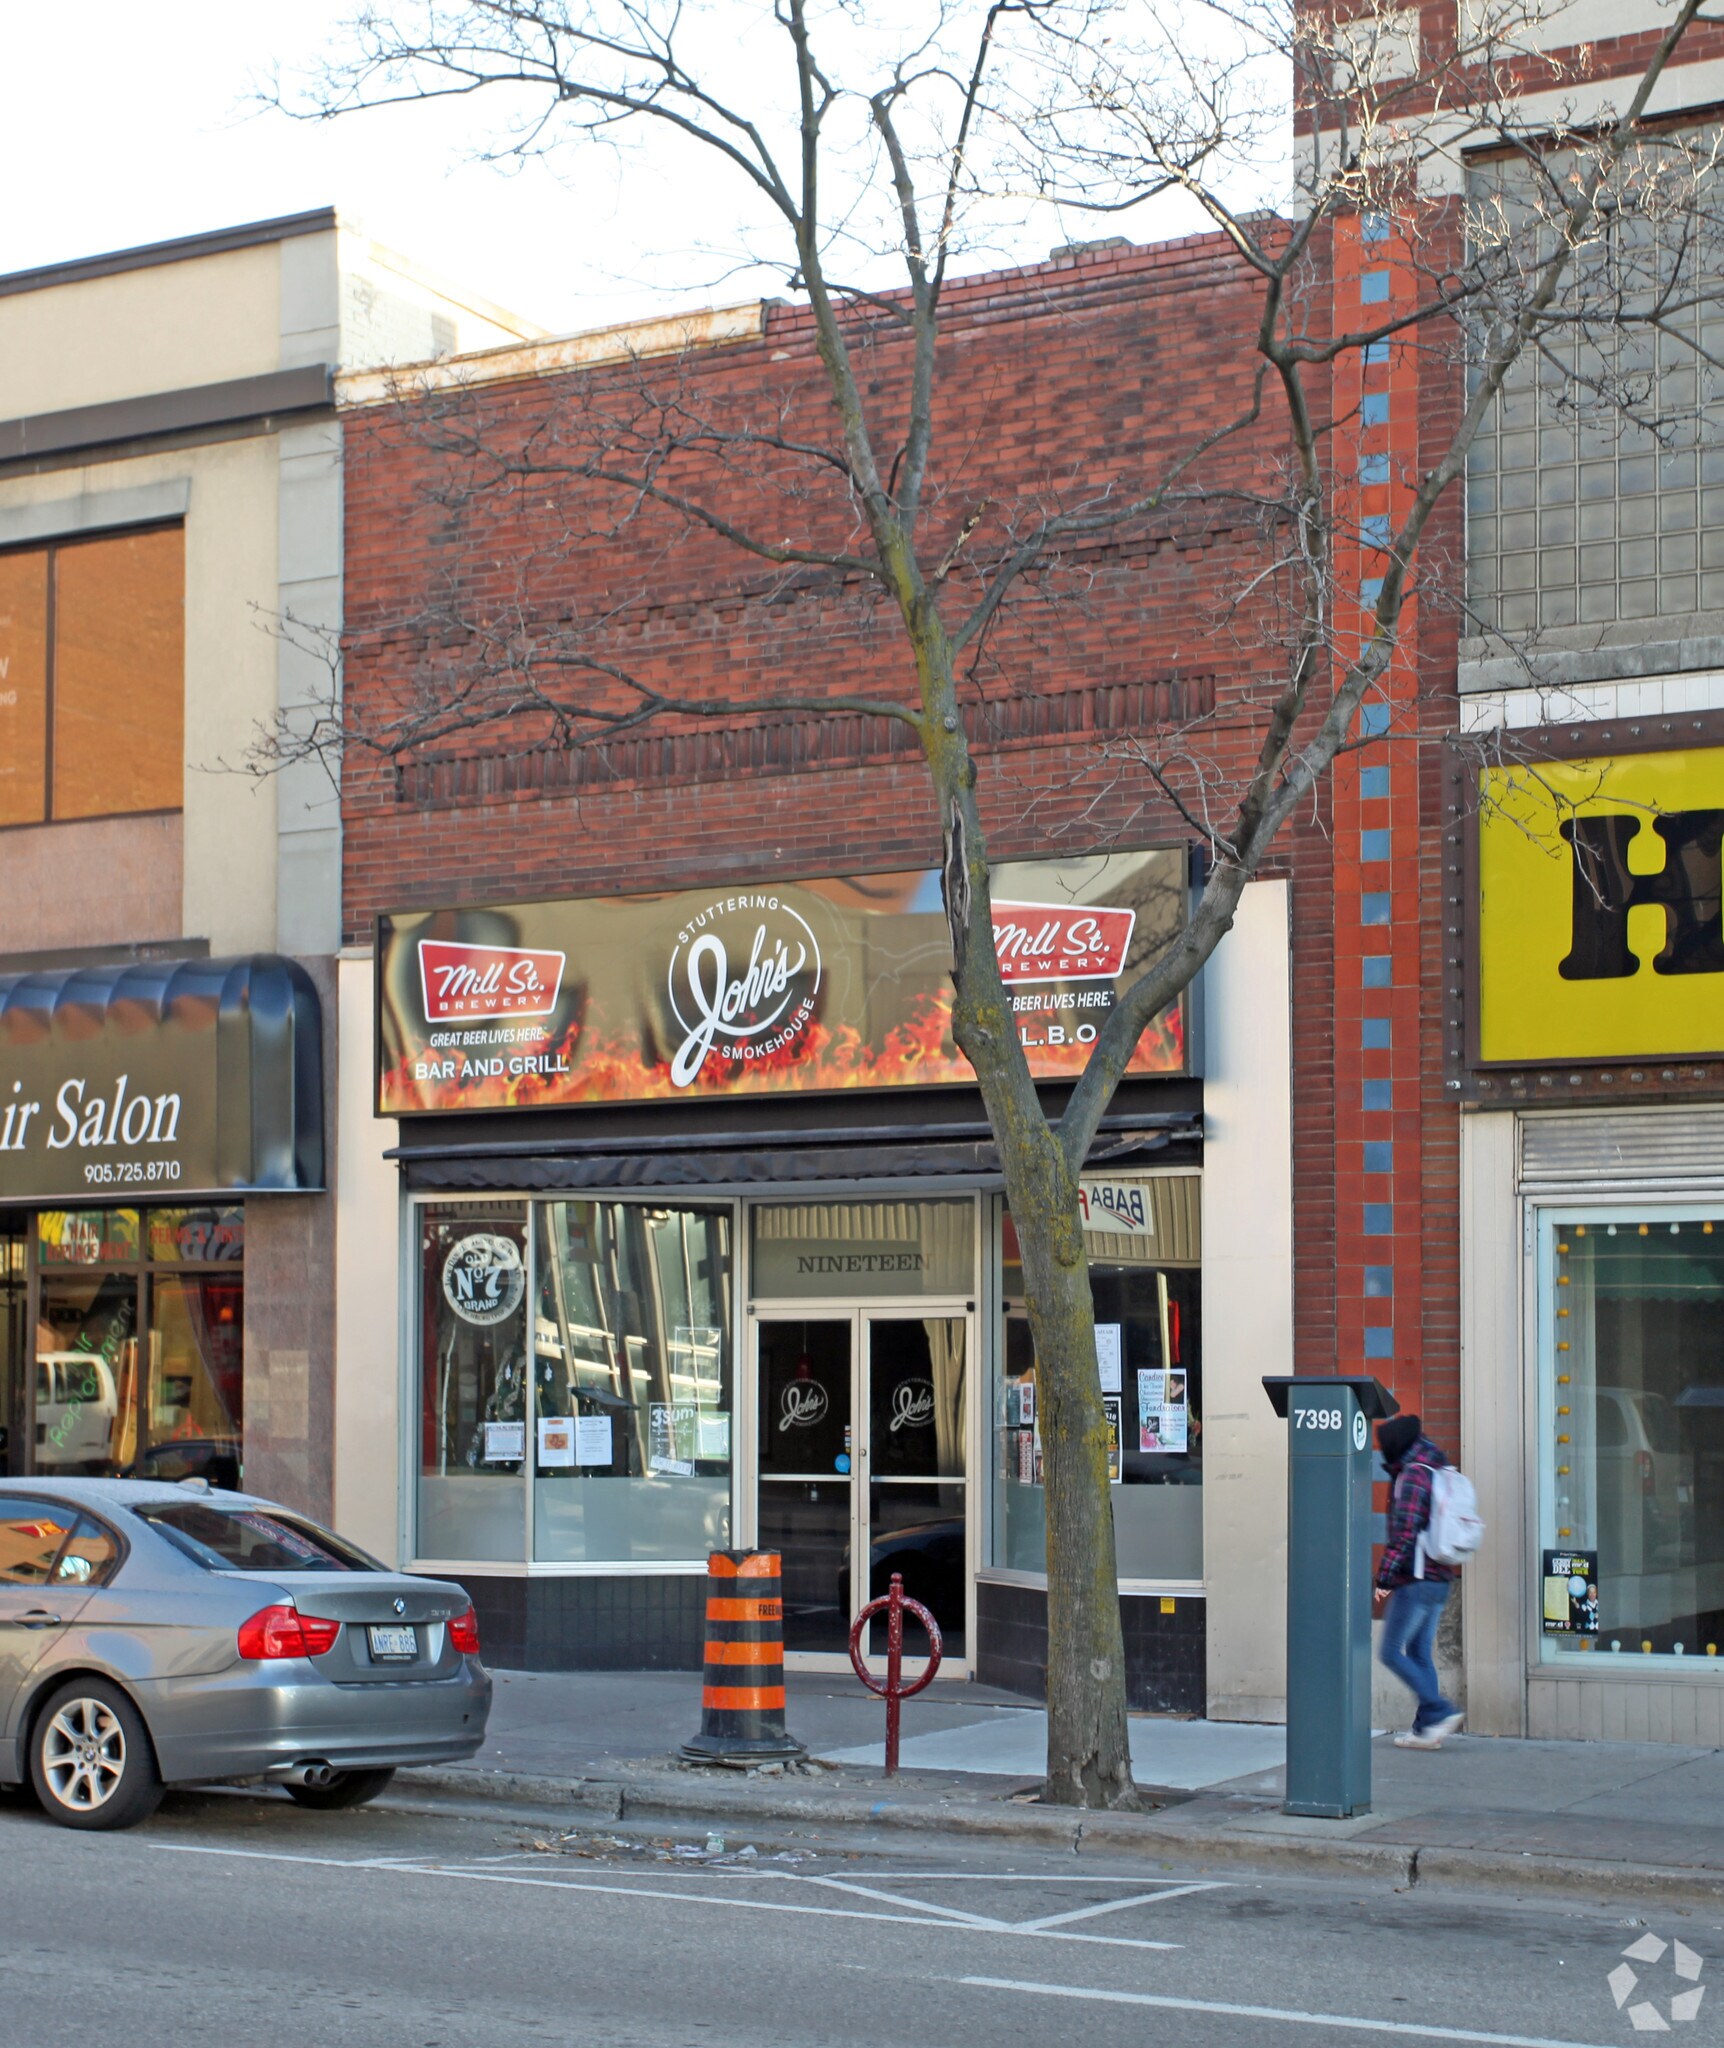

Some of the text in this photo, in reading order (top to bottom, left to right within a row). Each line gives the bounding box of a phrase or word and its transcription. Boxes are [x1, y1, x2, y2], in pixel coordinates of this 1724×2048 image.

[677, 895, 779, 943] STUTTERING
[991, 918, 1111, 958] Mill St.
[1002, 957, 1107, 973] REWERY
[433, 960, 545, 997] Mill St.
[439, 995, 542, 1011] BREWERY
[1013, 994, 1042, 1012] BEER
[1043, 992, 1075, 1009] LIVES
[430, 1029, 462, 1047] GREAT
[462, 1029, 488, 1046] BEER
[488, 1028, 516, 1044] LIVES
[721, 997, 815, 1059] SMOKEHOUSE
[415, 1055, 569, 1080] BAR AND GRILL
[47, 1074, 181, 1149] Salon
[84, 1160, 181, 1183] 905.725.8710
[797, 1253, 931, 1274] NINETEEN
[463, 1298, 499, 1312] BRAND
[1294, 1409, 1342, 1430] 7398
[1552, 1565, 1571, 1575] DEE
